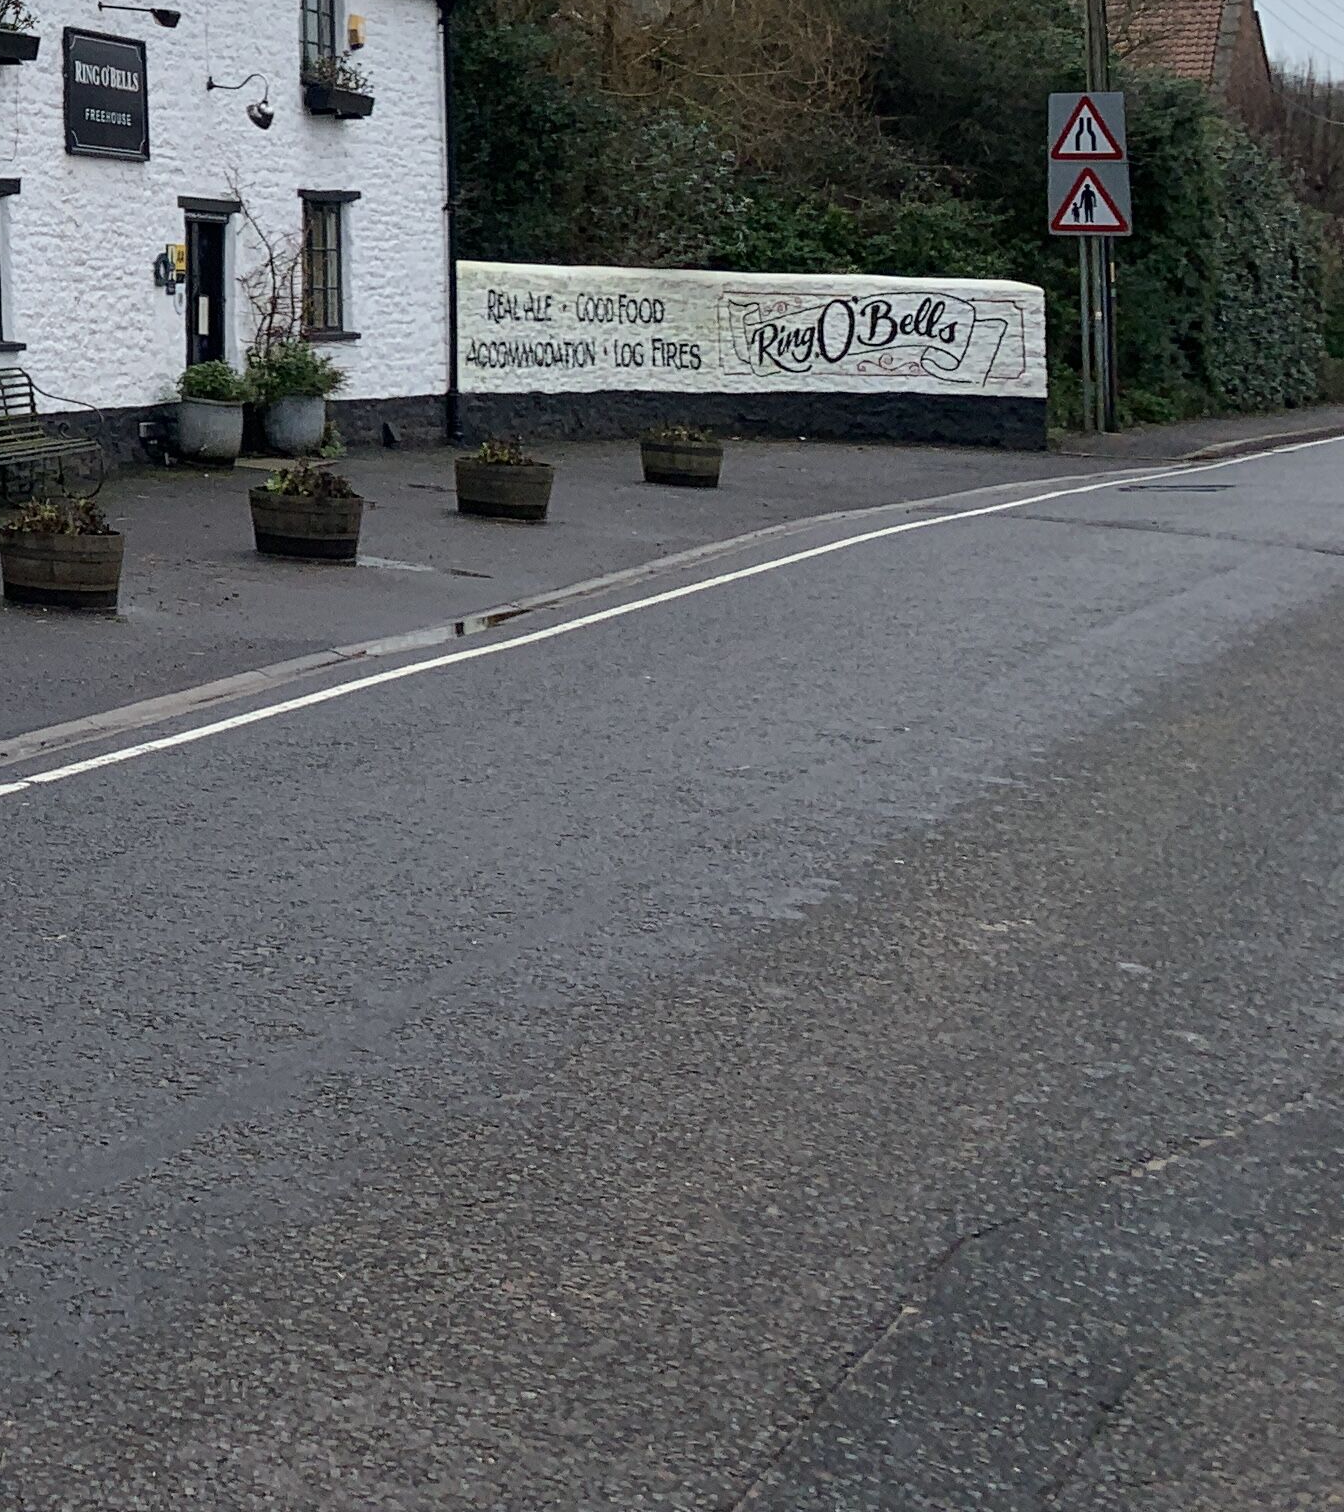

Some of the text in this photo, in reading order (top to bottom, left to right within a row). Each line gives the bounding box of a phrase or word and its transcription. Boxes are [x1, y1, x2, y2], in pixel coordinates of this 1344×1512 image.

[75, 60, 100, 85] RING
[85, 108, 132, 126] FREEHOUSE
[487, 289, 520, 324] REAL
[523, 291, 553, 322] ALE
[618, 294, 665, 324] FOOD
[465, 337, 702, 370] ACCOMMODATION LOG FIRES
[752, 323, 816, 373] Ring
